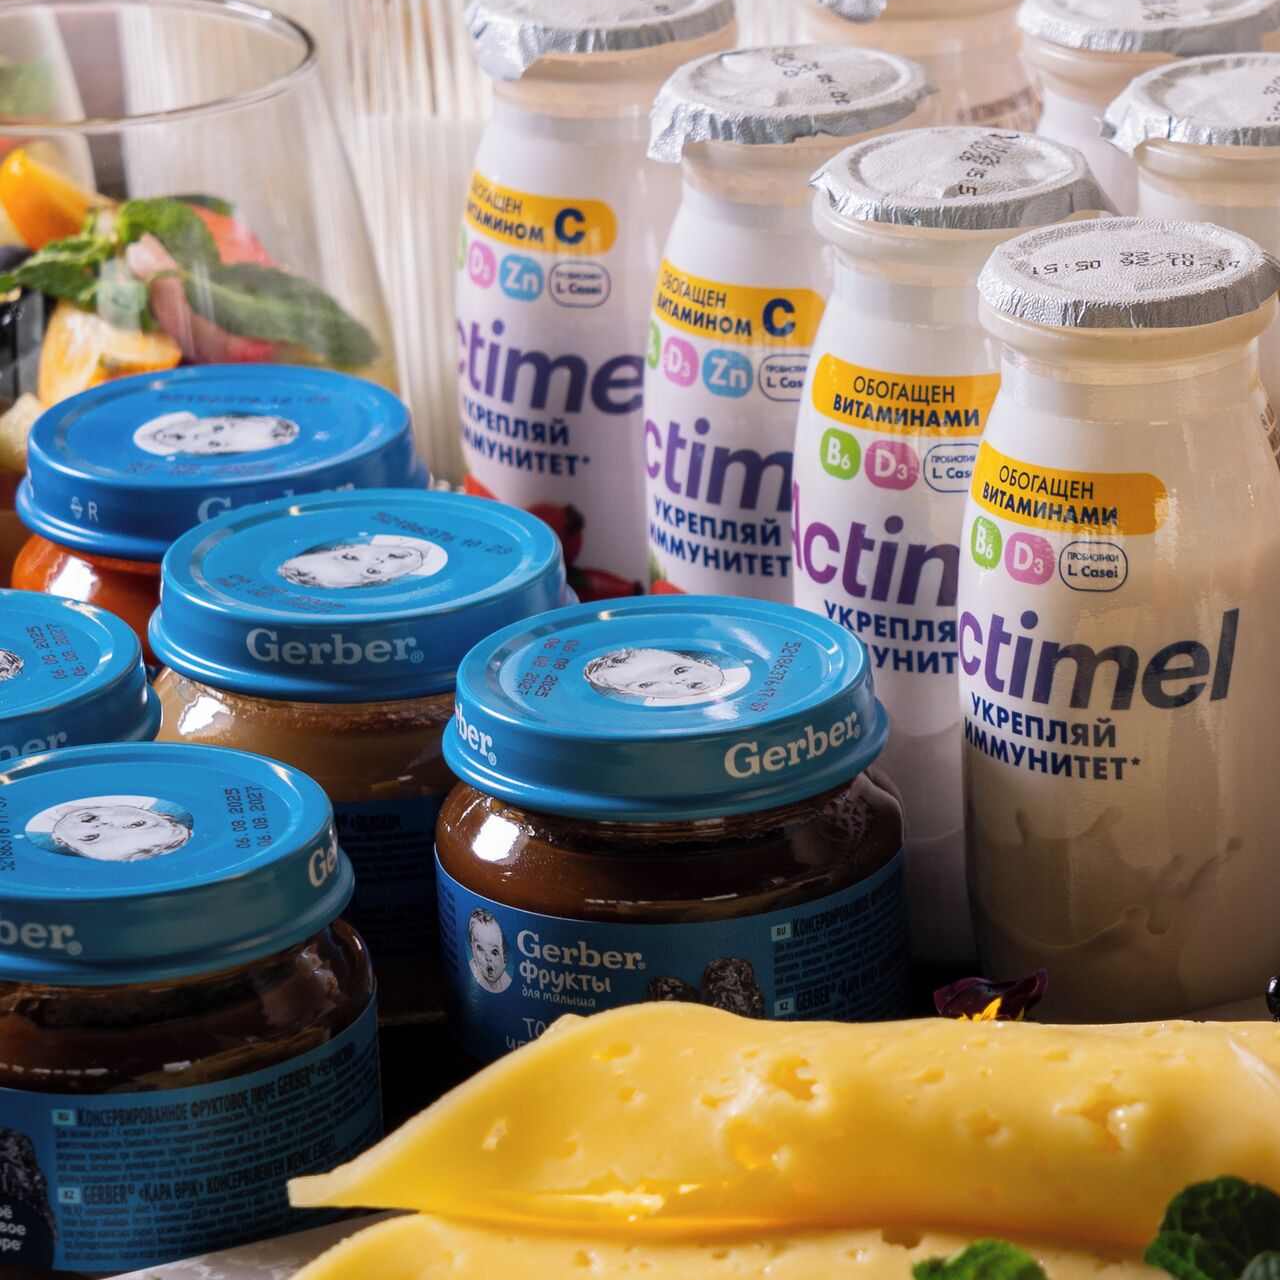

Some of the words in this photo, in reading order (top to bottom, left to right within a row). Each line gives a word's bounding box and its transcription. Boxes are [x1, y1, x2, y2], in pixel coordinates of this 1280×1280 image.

[504, 260, 540, 295] Zn
[708, 357, 747, 390] Zn
[779, 376, 804, 389] Cas
[852, 375, 956, 407] ОБОГАЩЕН
[832, 393, 981, 428] ВИТАМИНАМИ
[826, 435, 852, 471] B6
[873, 452, 909, 481] D3
[946, 466, 972, 480] Cas
[998, 465, 1094, 502] ОБОГАЩЕН
[654, 494, 782, 547] УКРЕПЛЯЙ
[982, 480, 1118, 527] ВИТАМИНАМИ
[1012, 541, 1044, 576] D3
[1080, 565, 1119, 579] Casei
[823, 599, 957, 643] УКРЕПЛЯ
[959, 607, 1241, 711] ctimel
[970, 691, 1117, 749] УКРЕПЛЯЙ
[519, 959, 611, 994] фрукты
[542, 991, 597, 1008] малыша
